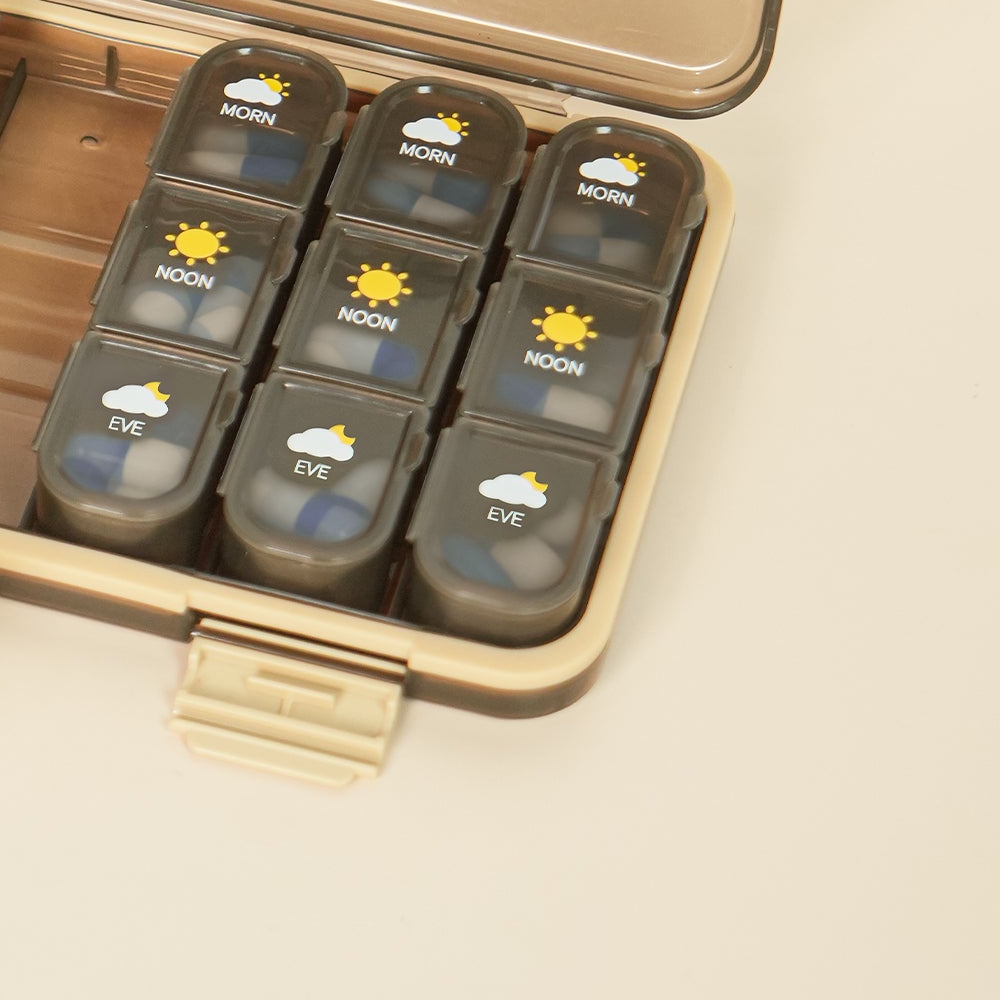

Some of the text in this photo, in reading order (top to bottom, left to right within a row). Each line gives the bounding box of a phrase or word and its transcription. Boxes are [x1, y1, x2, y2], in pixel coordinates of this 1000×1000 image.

[220, 103, 276, 125] MORN
[399, 143, 456, 165] MORN
[577, 183, 634, 207] MORN
[155, 265, 214, 289] NOON
[338, 306, 397, 331] NOON
[524, 350, 584, 376] NOON
[109, 416, 145, 436] EVE
[294, 460, 331, 480] EVE
[487, 507, 525, 527] EVE
